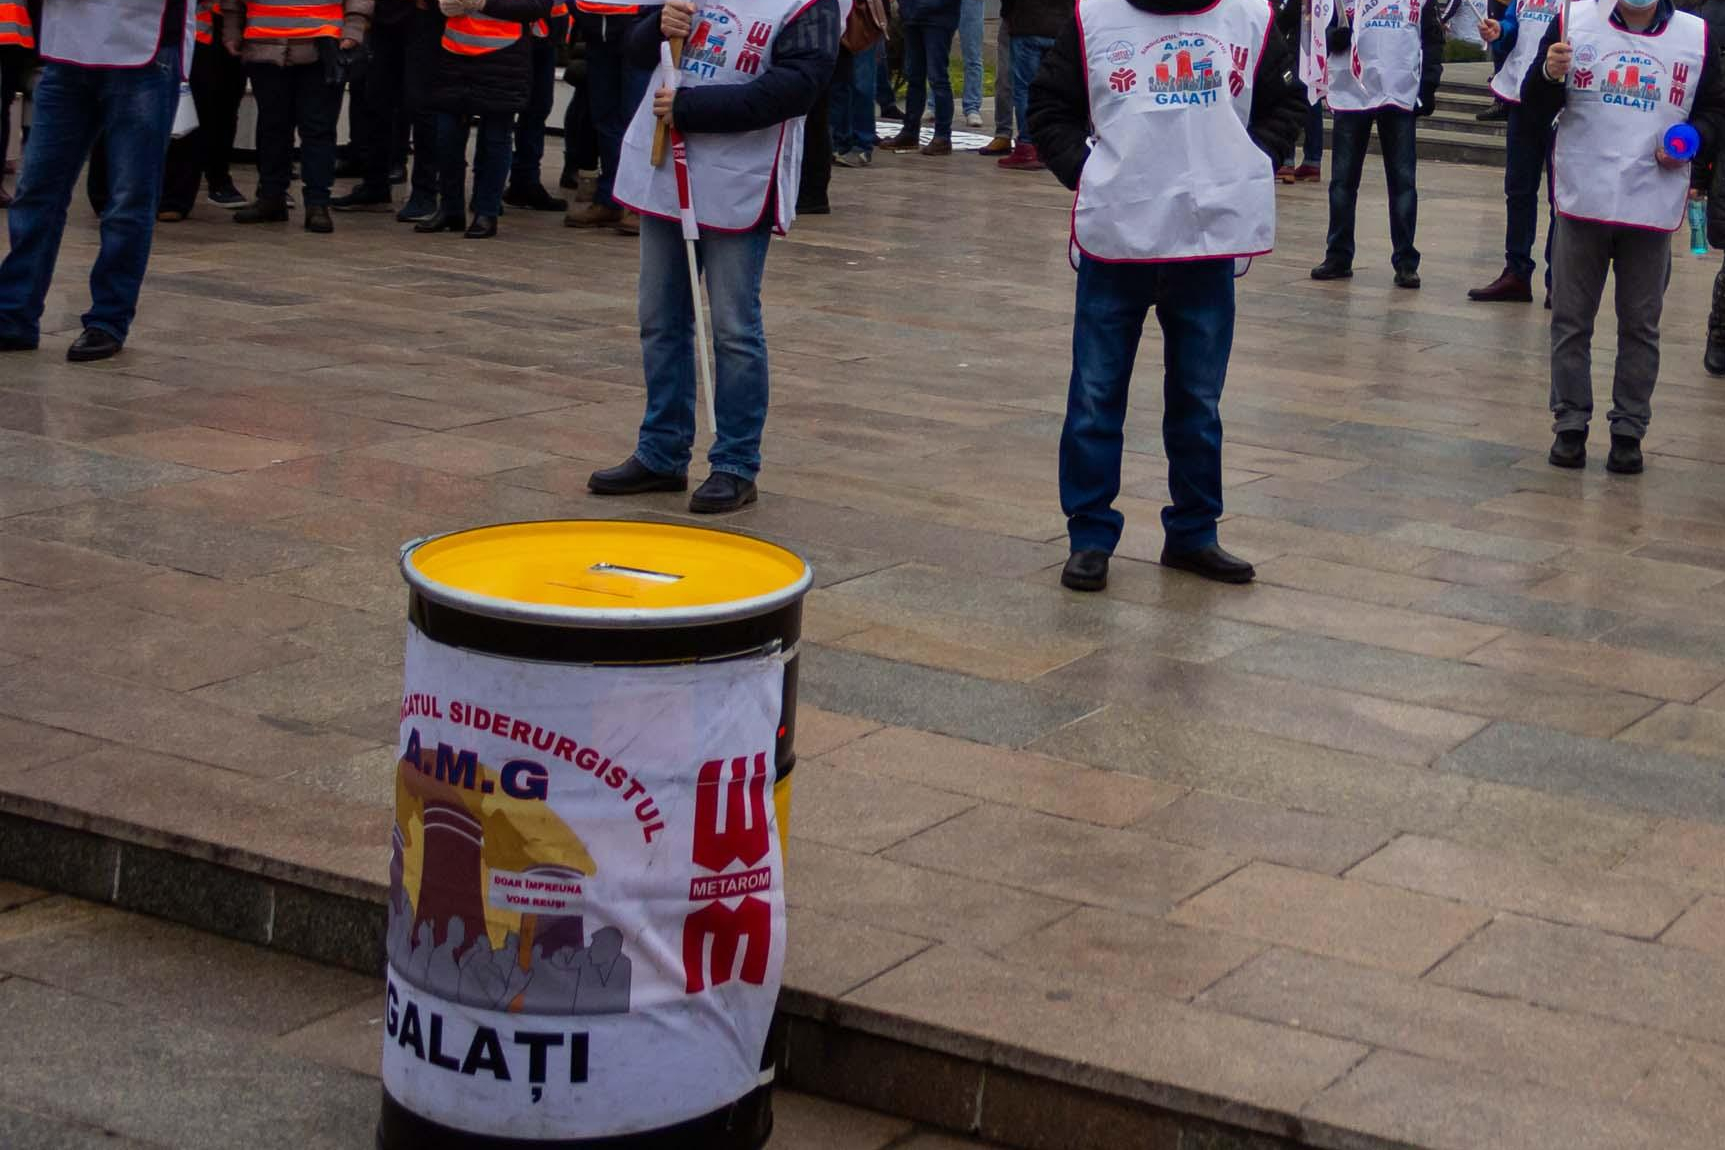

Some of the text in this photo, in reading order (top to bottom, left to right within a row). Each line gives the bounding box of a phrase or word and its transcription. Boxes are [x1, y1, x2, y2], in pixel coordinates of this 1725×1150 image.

[1164, 38, 1205, 50] A.M.G
[405, 727, 549, 801] A.M.G
[449, 701, 665, 844] SIDERURGISTUL
[692, 872, 771, 897] METAROM
[385, 979, 589, 1104] GALAȚI
